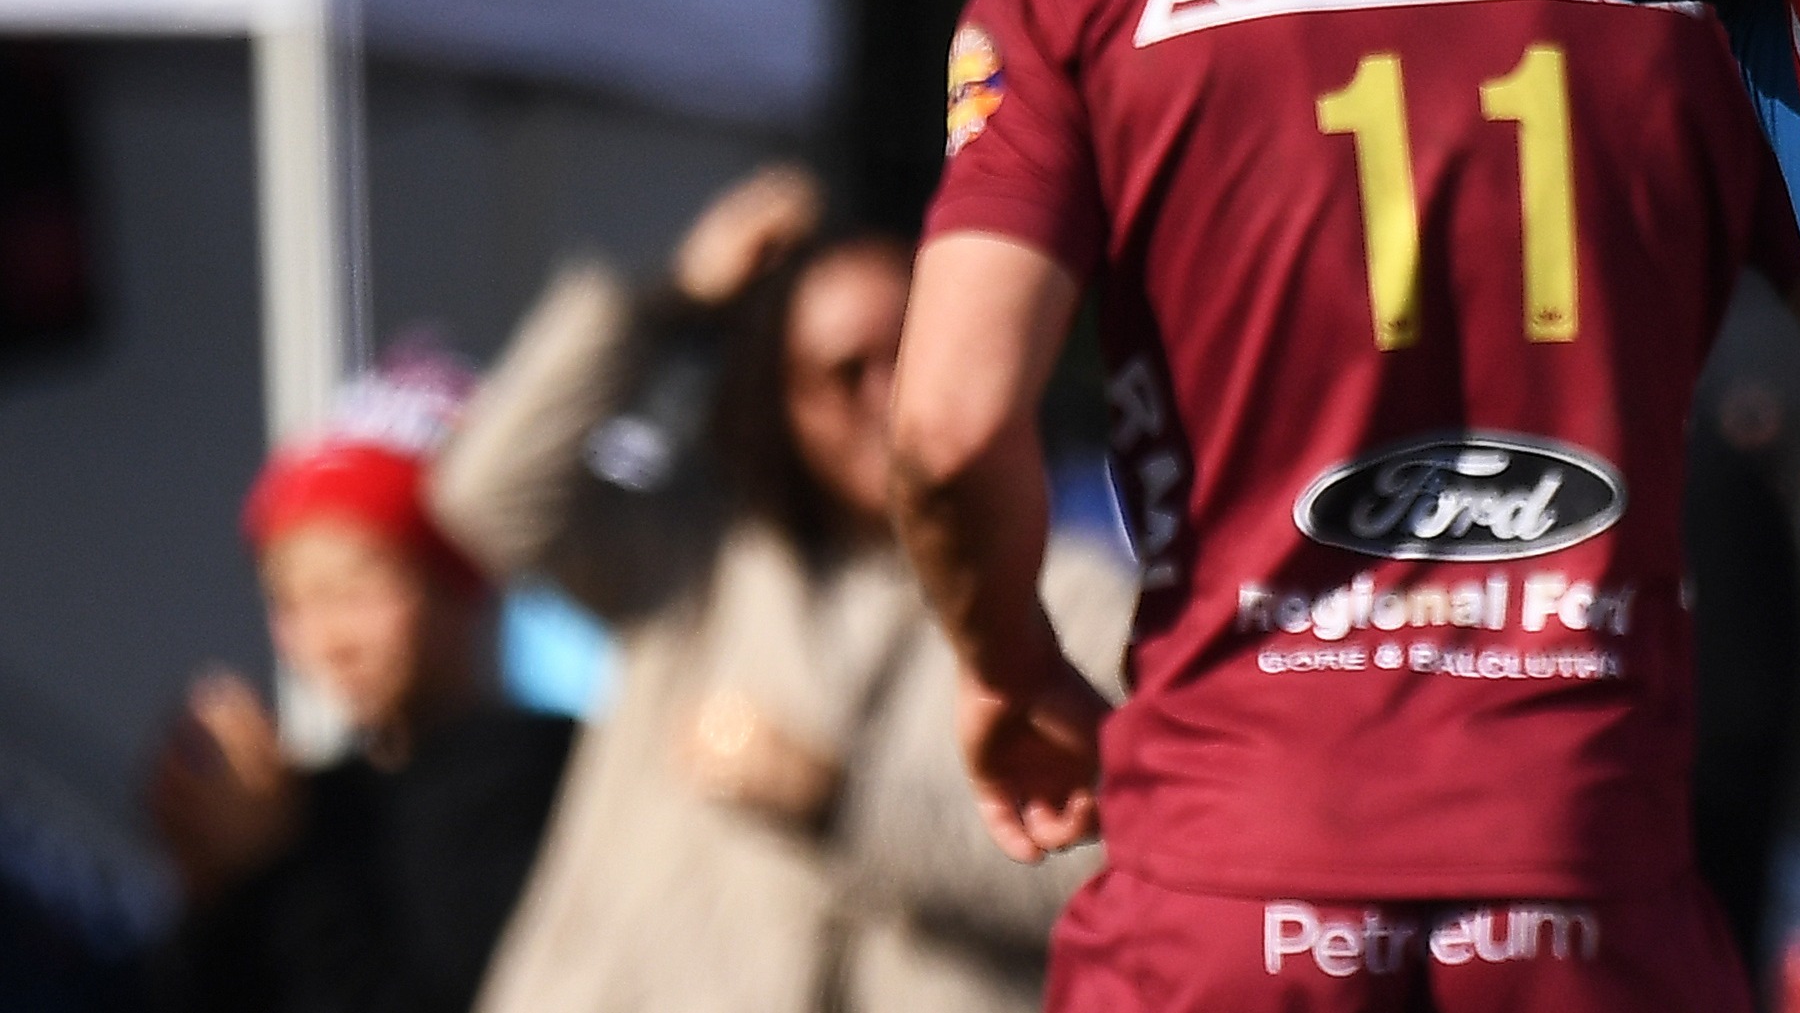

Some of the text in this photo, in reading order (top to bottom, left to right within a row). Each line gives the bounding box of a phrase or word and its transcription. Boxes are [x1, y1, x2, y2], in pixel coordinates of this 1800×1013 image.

[1314, 43, 1579, 352] 11
[1350, 450, 1565, 540] Ford
[1238, 570, 1510, 641] Regional
